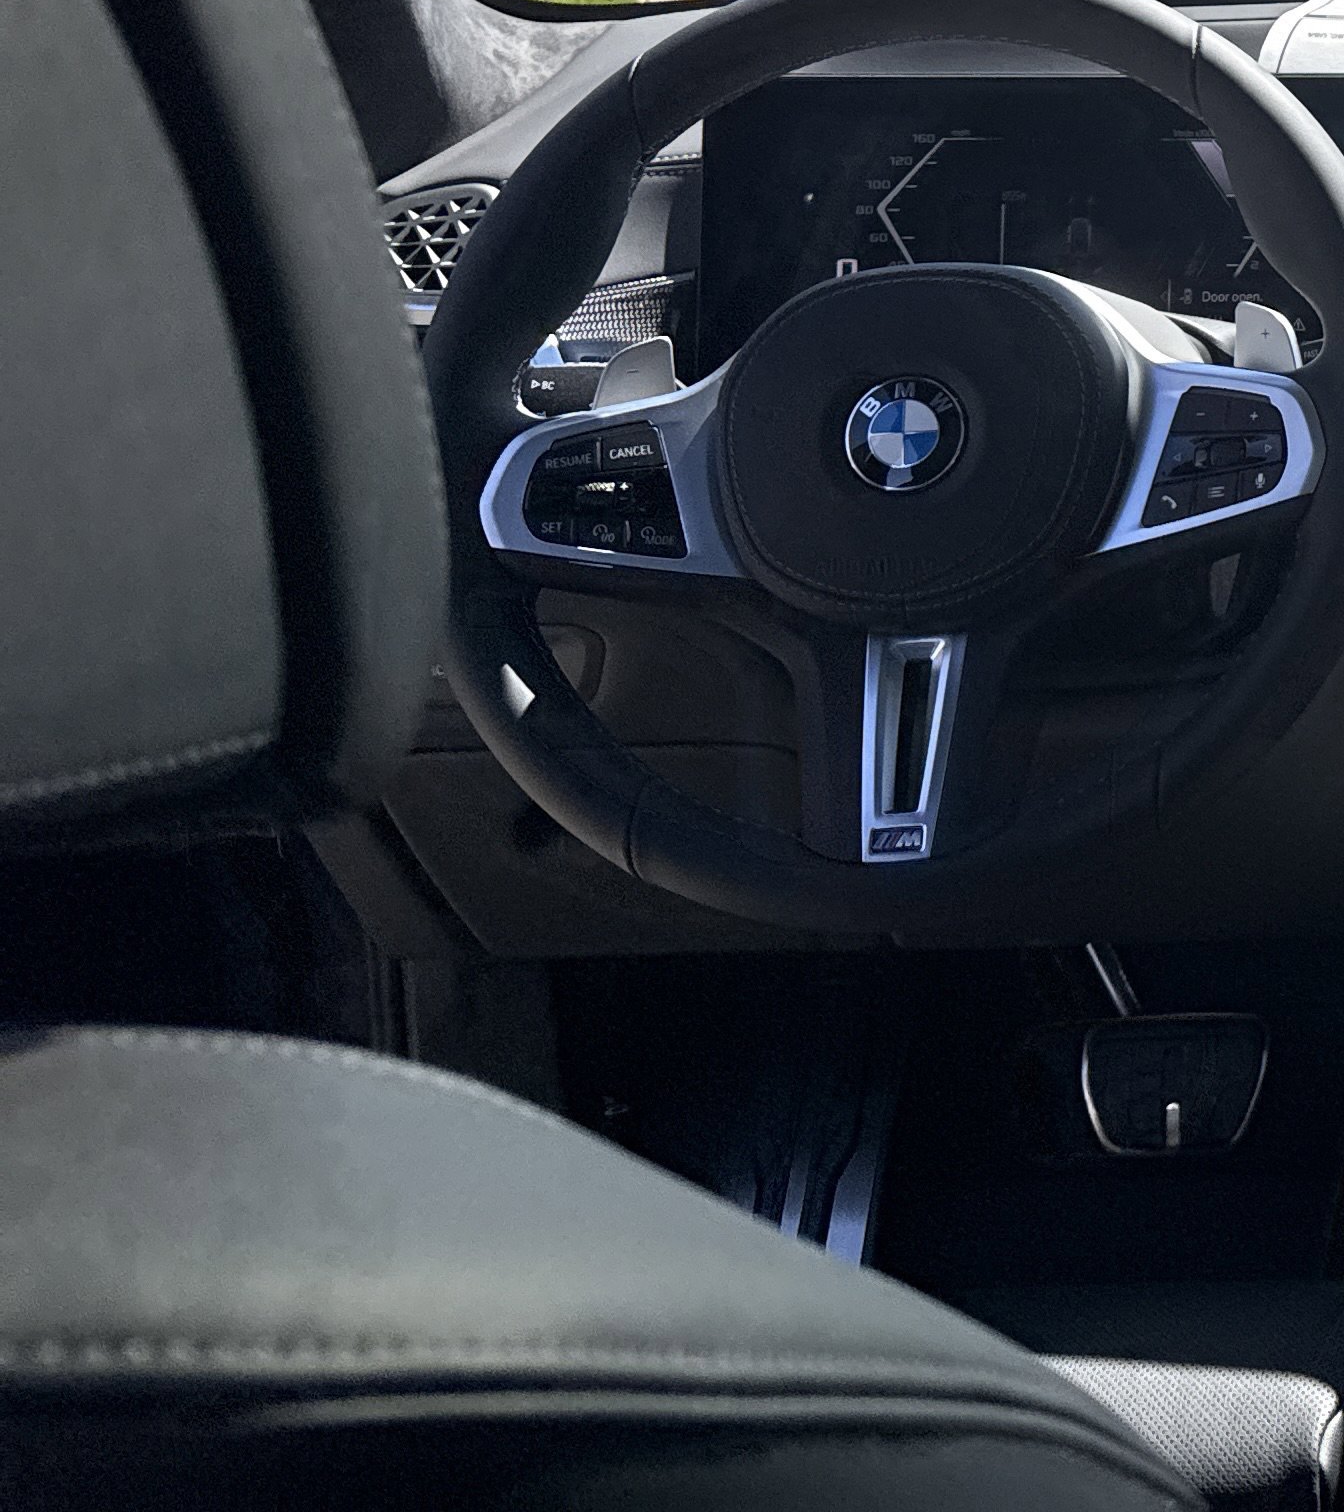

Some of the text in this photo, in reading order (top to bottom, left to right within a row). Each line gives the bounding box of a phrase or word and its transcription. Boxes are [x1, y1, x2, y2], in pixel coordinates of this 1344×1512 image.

[912, 134, 935, 144] 160
[889, 156, 913, 166] 120
[865, 180, 891, 190] 100
[856, 205, 874, 215] 80
[869, 233, 888, 243] 60
[1201, 291, 1229, 302] Door
[541, 380, 555, 390] BC
[859, 381, 954, 418] BMW
[609, 444, 655, 460] CANCEL
[545, 453, 592, 470] RESUME
[541, 522, 563, 534] SET
[645, 535, 676, 546] MODE
